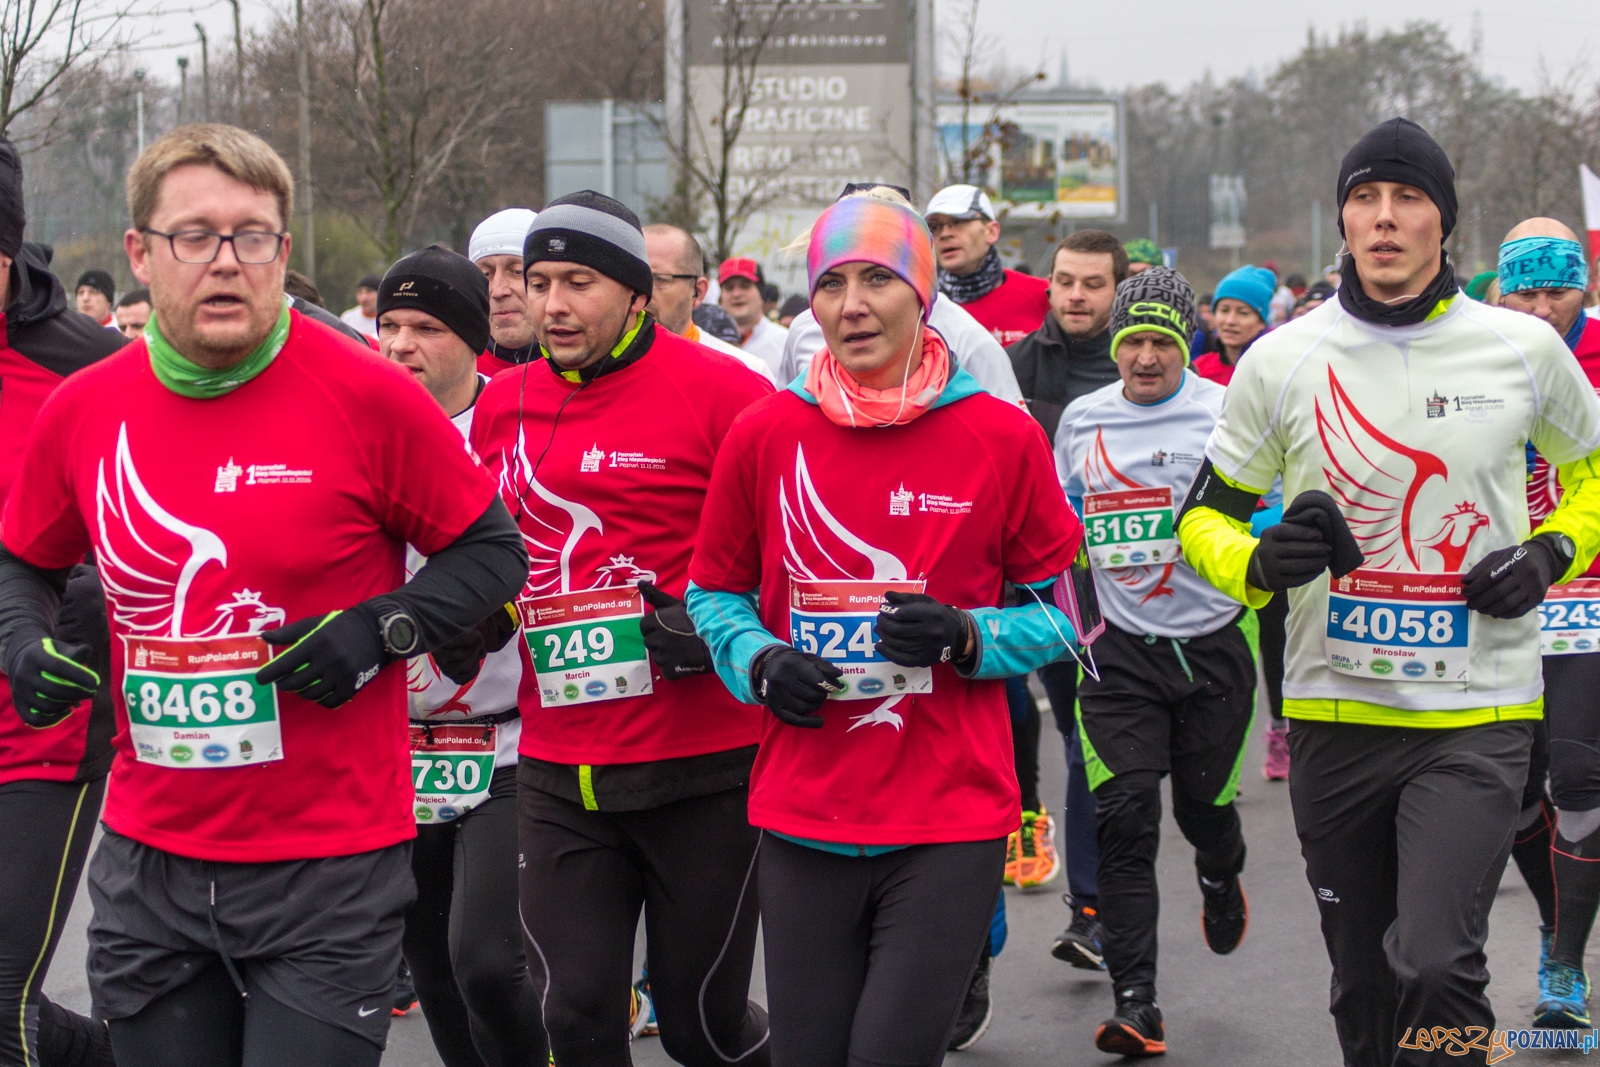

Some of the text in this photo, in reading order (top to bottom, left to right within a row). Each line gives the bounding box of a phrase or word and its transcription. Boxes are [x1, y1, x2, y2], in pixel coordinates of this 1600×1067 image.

[750, 76, 847, 100] STUDIO
[1453, 396, 1463, 411] 1
[609, 451, 617, 467] 1
[246, 464, 256, 485] 1
[918, 493, 928, 511] 1
[1093, 514, 1163, 543] 5167
[1403, 585, 1462, 595] RunPoland.org
[573, 600, 631, 612] RunPoland.org
[879, 604, 899, 614] FOX
[1537, 604, 1600, 628] 5243
[1330, 605, 1454, 644] E 4058
[793, 621, 882, 658] E 524
[531, 627, 614, 668] C 249
[1373, 647, 1416, 657] Mirosław
[188, 650, 258, 664] RunPoland.org
[1332, 654, 1350, 663] GRUPA
[1332, 661, 1354, 670] LUXMED
[565, 671, 590, 680] Marcin
[127, 680, 256, 723] C 8468
[174, 731, 210, 740] Damian
[434, 737, 486, 745] RunPoland.org
[412, 759, 481, 791] 730
